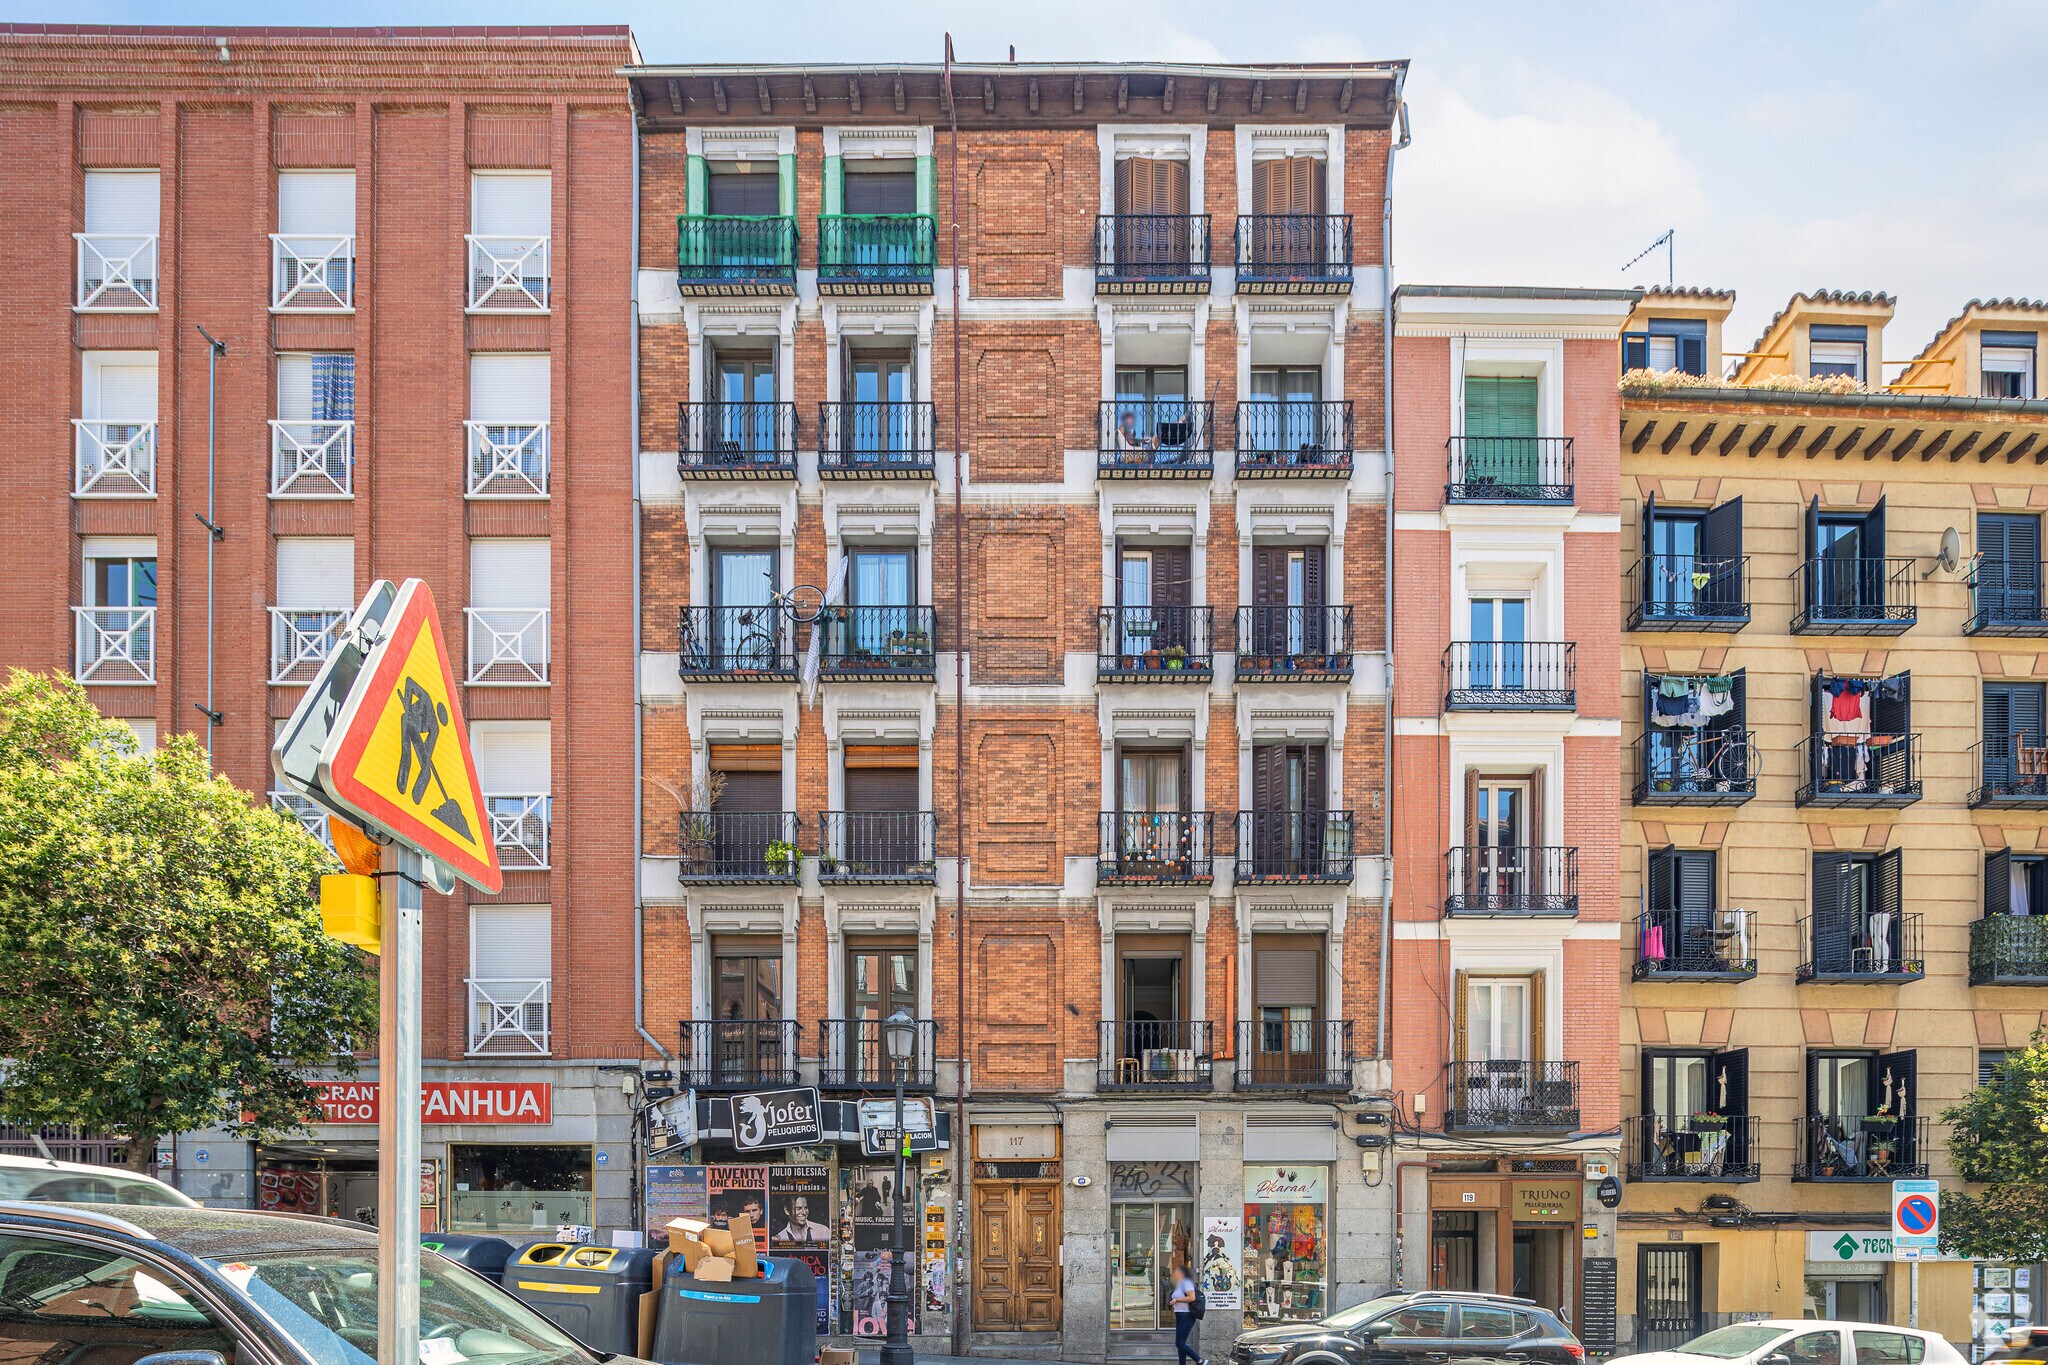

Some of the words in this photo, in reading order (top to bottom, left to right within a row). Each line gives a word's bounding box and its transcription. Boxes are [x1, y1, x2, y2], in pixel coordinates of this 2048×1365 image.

[323, 1104, 373, 1119] TICO
[767, 1101, 813, 1128] Jofer
[767, 1124, 817, 1137] PELUQUEROS
[1009, 1137, 1024, 1146] 117
[710, 1168, 765, 1179] TWENTY
[771, 1168, 792, 1177] JULIO
[794, 1167, 827, 1177] IGLESIAS
[710, 1179, 730, 1188] ONE
[732, 1179, 765, 1188] PILOTS
[1464, 1194, 1474, 1202] 119
[1518, 1189, 1571, 1200] TRIUNO
[1863, 1239, 1892, 1254] TECN
